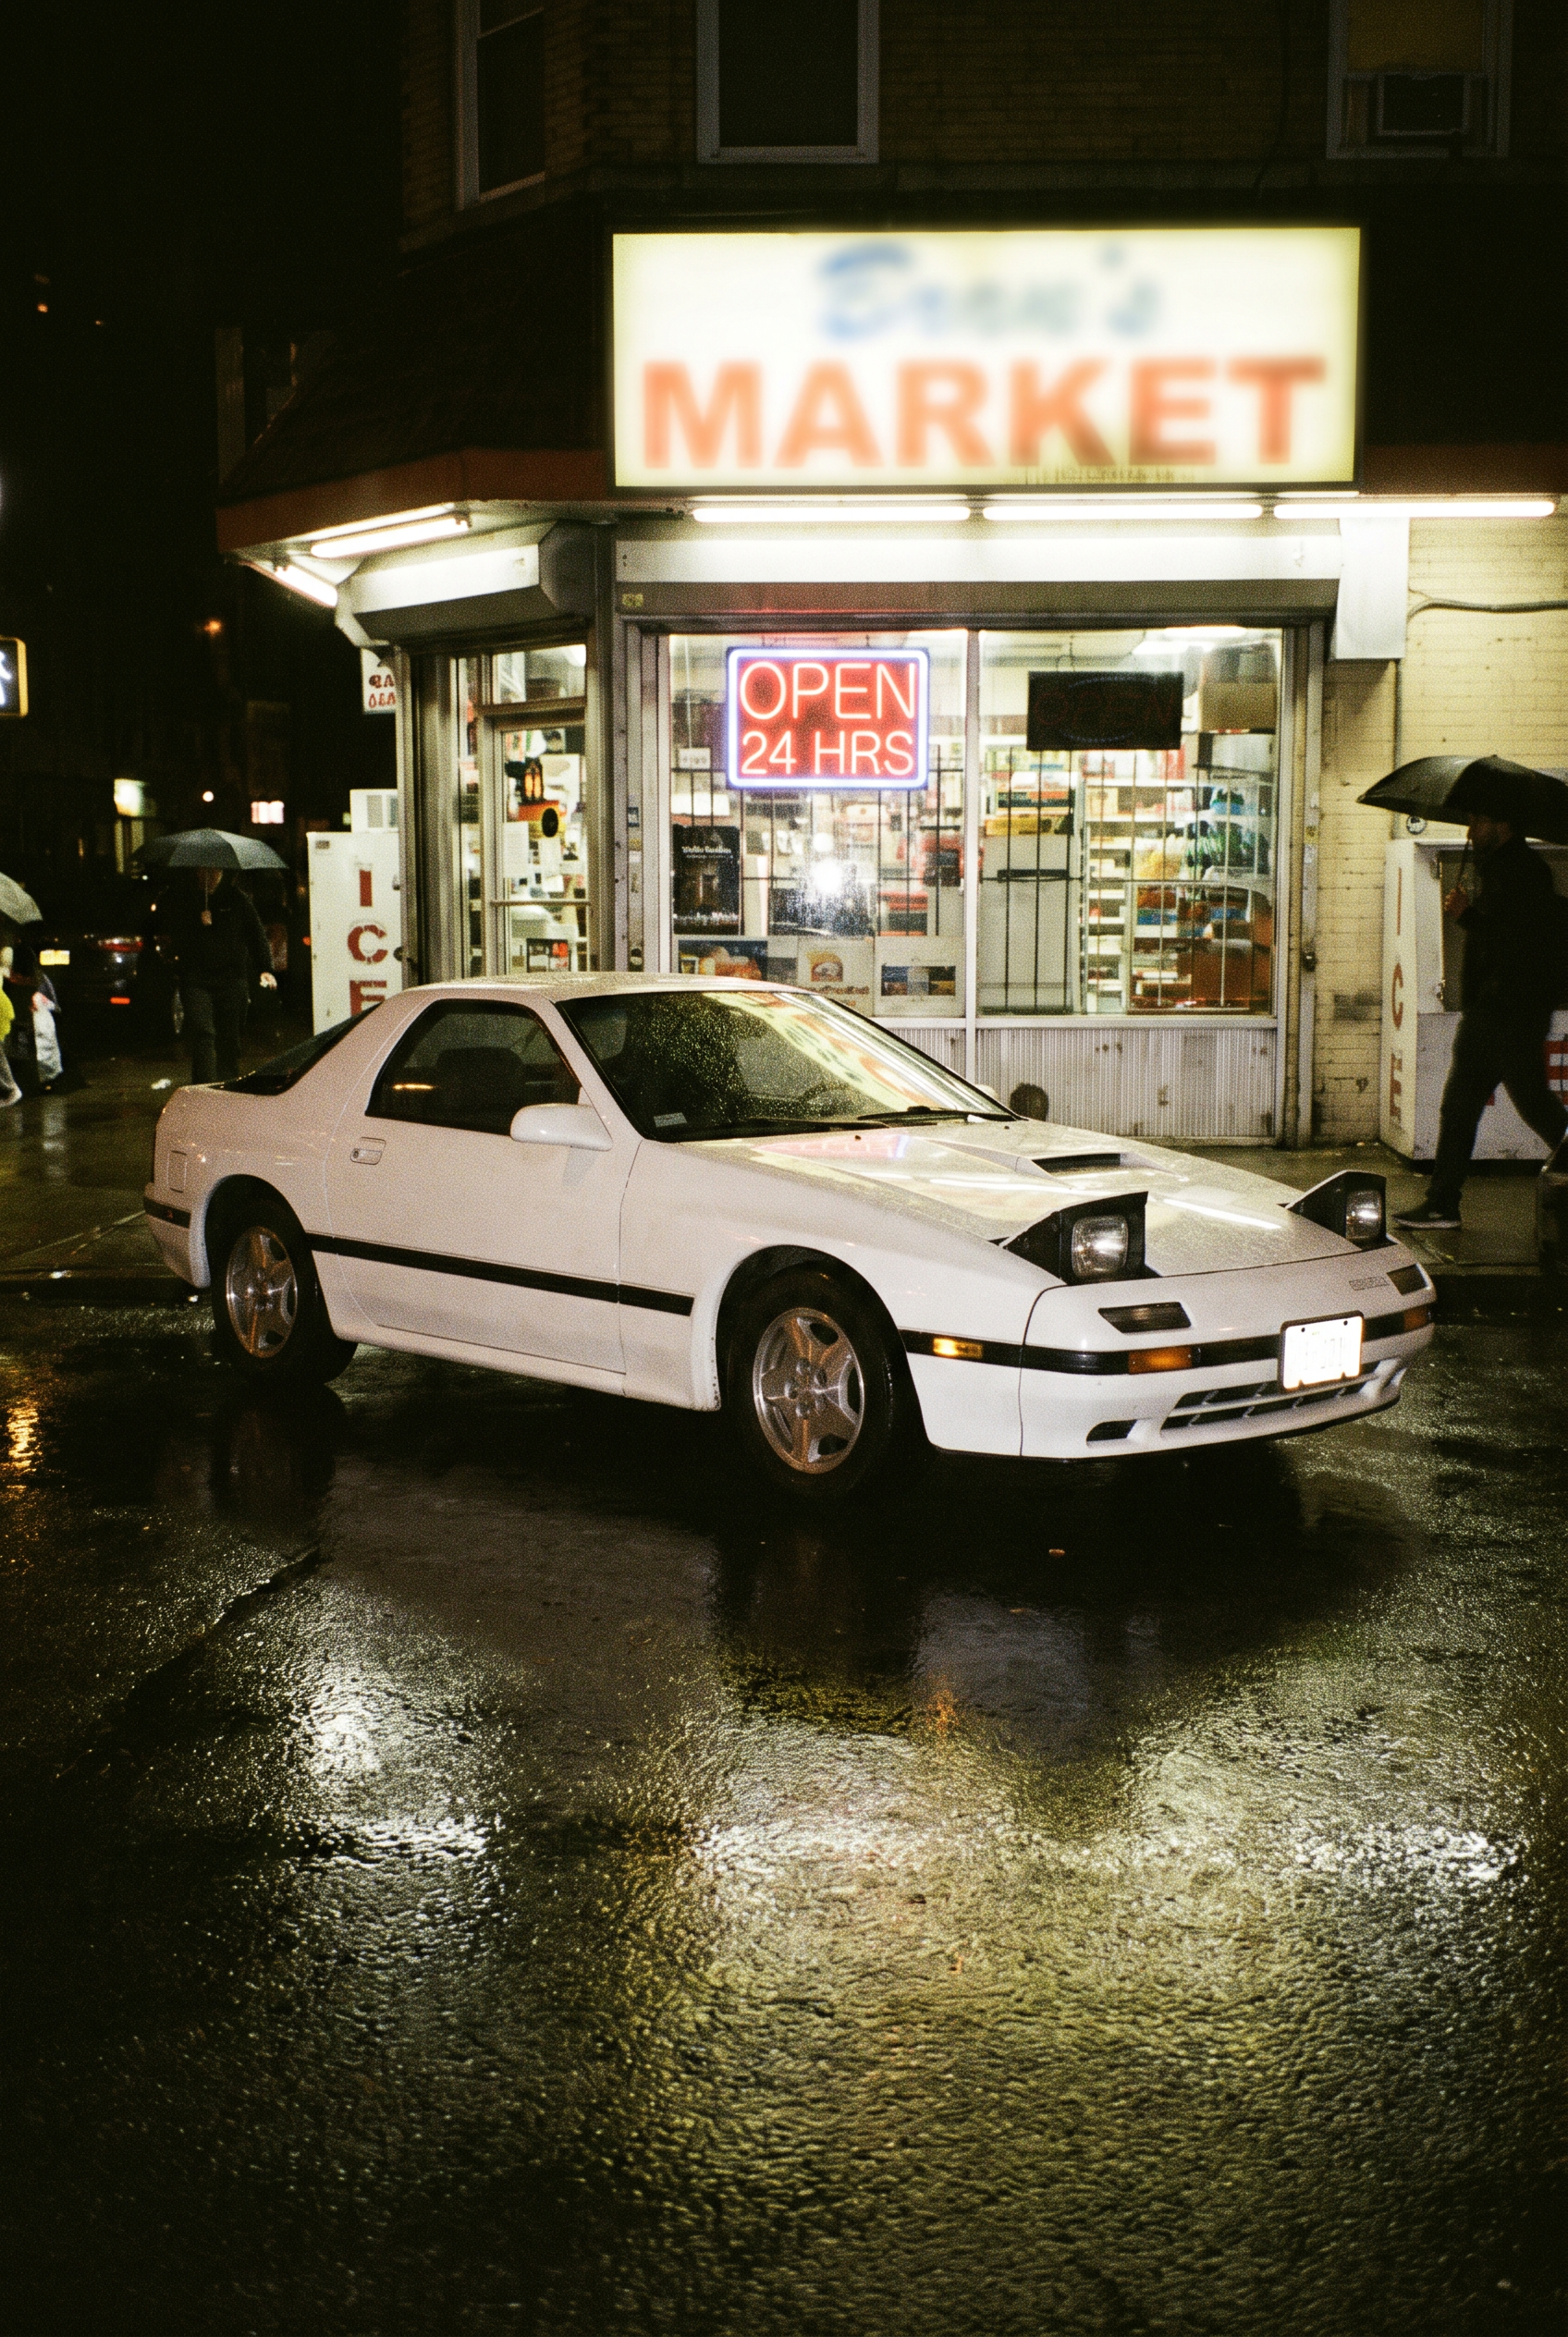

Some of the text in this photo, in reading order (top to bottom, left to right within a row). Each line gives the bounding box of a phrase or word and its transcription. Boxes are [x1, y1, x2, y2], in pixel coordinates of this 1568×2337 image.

[642, 355, 1328, 470] MARKET
[741, 661, 916, 721] OPEN
[741, 729, 915, 777] 24 HRS
[1389, 865, 1404, 1130] ICE
